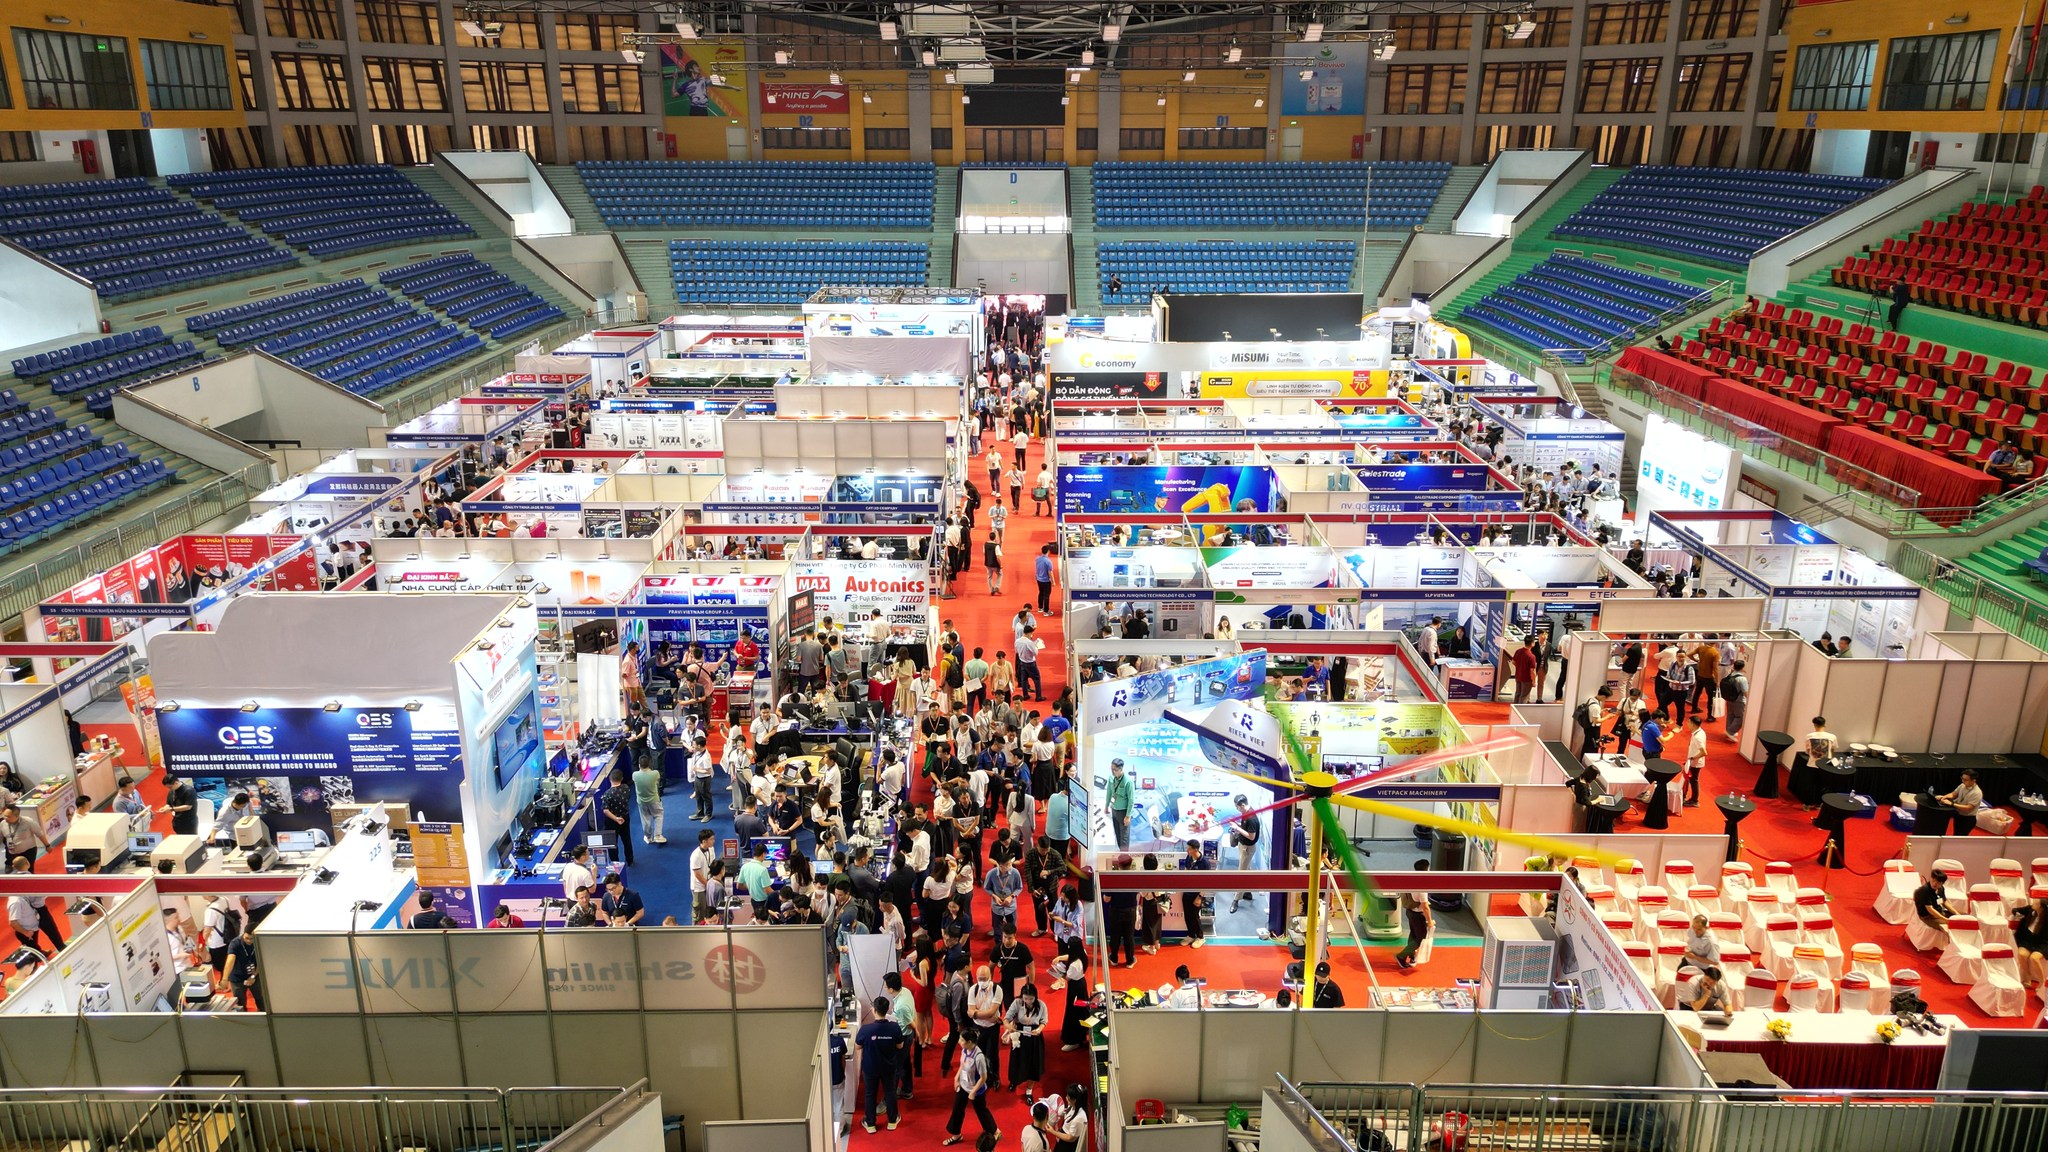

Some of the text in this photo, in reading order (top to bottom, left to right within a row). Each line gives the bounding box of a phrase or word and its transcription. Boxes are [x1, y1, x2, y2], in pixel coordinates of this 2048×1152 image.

[141, 110, 152, 128] B1
[799, 115, 813, 127] D2
[1216, 115, 1229, 127] D1
[1805, 112, 1818, 128] A2
[1010, 173, 1018, 184] D
[1095, 360, 1137, 369] economy
[193, 375, 201, 392] B
[1087, 386, 1111, 396] ĐỘNG
[406, 573, 423, 581] ĐẠI
[423, 573, 438, 581] KINH
[845, 575, 925, 592] Autonics
[798, 577, 829, 591] MAX
[356, 713, 393, 726] QES
[1096, 708, 1142, 725] RIKEN VIET
[218, 726, 274, 745] QES
[1052, 727, 1060, 736] 15
[1228, 726, 1247, 740] RIKEN
[171, 754, 209, 763] PRECISION
[254, 753, 280, 762] DRIVEN
[281, 753, 291, 762] BY
[292, 753, 334, 761] INNOVATION
[171, 763, 225, 771] COMPREHENSIVE
[225, 763, 262, 771] SOLUTIONS
[281, 762, 304, 770] MICRO
[305, 762, 314, 770] TO
[314, 762, 338, 770] MACRO
[369, 842, 382, 862] 225
